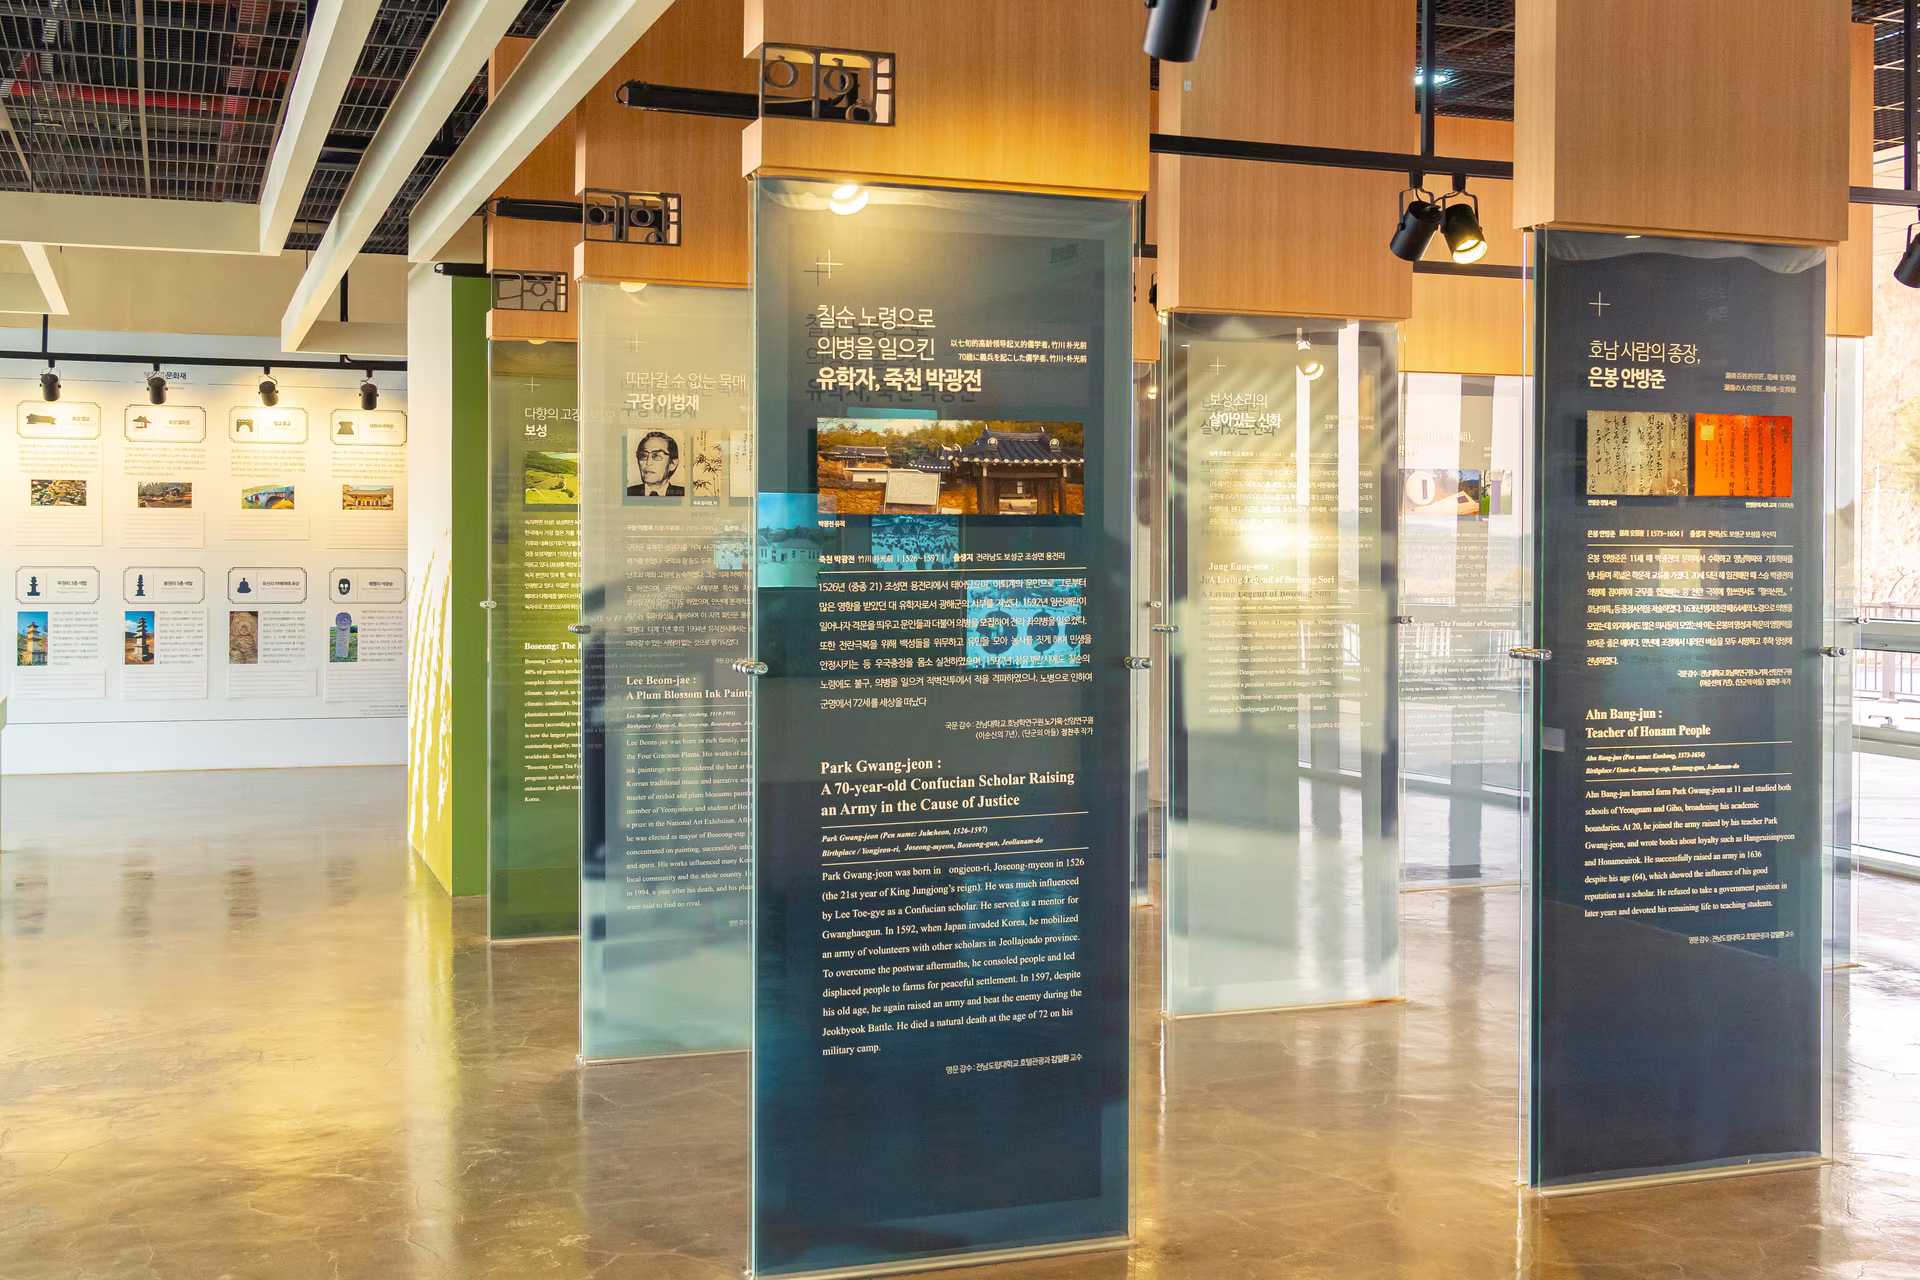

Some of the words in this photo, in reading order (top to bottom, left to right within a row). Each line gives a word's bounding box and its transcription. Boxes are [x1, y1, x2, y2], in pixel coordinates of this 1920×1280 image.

[816, 304, 856, 329] 칠순
[858, 307, 936, 330] 노령으로
[816, 336, 876, 360] 의병을
[878, 337, 934, 361] 일으킨
[1588, 340, 1620, 361] 호남
[1620, 341, 1665, 363] 사람의
[1667, 343, 1700, 364] 종장,
[165, 372, 187, 380] 문화재
[626, 371, 670, 388] 따라갈
[671, 373, 686, 388] 수
[688, 373, 717, 389] 없는
[816, 366, 880, 391] 유학자,
[883, 368, 922, 391] 죽천
[926, 368, 982, 392] 박광전
[1588, 366, 1619, 388] 은봉
[1621, 368, 1666, 389] 안방준
[626, 393, 656, 410] 구당
[658, 393, 699, 411] 이범재
[1209, 392, 1268, 409] 보성소리의
[525, 407, 558, 421] 다향의
[1208, 412, 1257, 428] 살아있는
[1258, 413, 1282, 429] 신화
[524, 424, 547, 437] 보성
[1207, 576, 1215, 584] A
[1217, 575, 1242, 585] Living
[1245, 576, 1273, 586] Legend
[1274, 575, 1284, 584] of
[1285, 575, 1317, 586] Boseong
[1318, 575, 1334, 584] Sori
[524, 642, 559, 651] Boseong:
[626, 676, 643, 685] Lee
[646, 675, 690, 686] Beom-jae
[626, 692, 634, 700] A
[637, 691, 661, 700] Plum
[664, 690, 702, 699] Blossom
[705, 689, 721, 698] Ink
[725, 688, 752, 698] Painte
[1585, 709, 1607, 720] Ahn
[1610, 708, 1656, 722] Bang-jun
[1585, 727, 1626, 738] Teacher
[1627, 726, 1639, 737] of
[1640, 726, 1676, 737] Honam
[1678, 724, 1711, 738] People
[821, 761, 853, 774] Park
[856, 758, 933, 774] Gwang-jeon
[821, 783, 832, 795] A
[834, 779, 907, 797] 70-year-old
[910, 776, 975, 791] Confucian
[979, 773, 1026, 787] Scholar
[1029, 771, 1075, 786] Raising
[821, 807, 837, 816] an
[840, 803, 877, 817] Army
[881, 801, 893, 813] in
[897, 800, 917, 812] the
[920, 798, 959, 811] Cause
[962, 796, 976, 808] of
[977, 794, 1020, 808] Justice
[822, 871, 841, 881] Park
[843, 869, 893, 881] Gwang-jeon
[912, 867, 931, 876] born
[933, 866, 941, 874] in
[994, 862, 1054, 872] Joseong-myeon
[1056, 859, 1064, 867] in
[1066, 858, 1085, 867] 1526
[1584, 909, 1599, 917] later
[1600, 910, 1617, 918] years
[1618, 907, 1630, 915] and
[1631, 905, 1656, 915] devoted
[1657, 905, 1667, 913] his
[1668, 903, 1699, 913] remaining
[1701, 902, 1712, 910] life
[1720, 901, 1746, 910] teaching
[1747, 900, 1773, 908] students.
[822, 969, 834, 978] To
[835, 968, 876, 977] overcome
[878, 965, 891, 974] the
[892, 964, 925, 975] postwar
[926, 960, 970, 970] aftermaths,
[972, 959, 981, 967] he
[983, 955, 1018, 966] consoled
[1020, 954, 1046, 966] people
[1047, 952, 1062, 961] and
[1063, 951, 1075, 960] led
[822, 1046, 855, 1056] military
[856, 1045, 881, 1053] camp.
